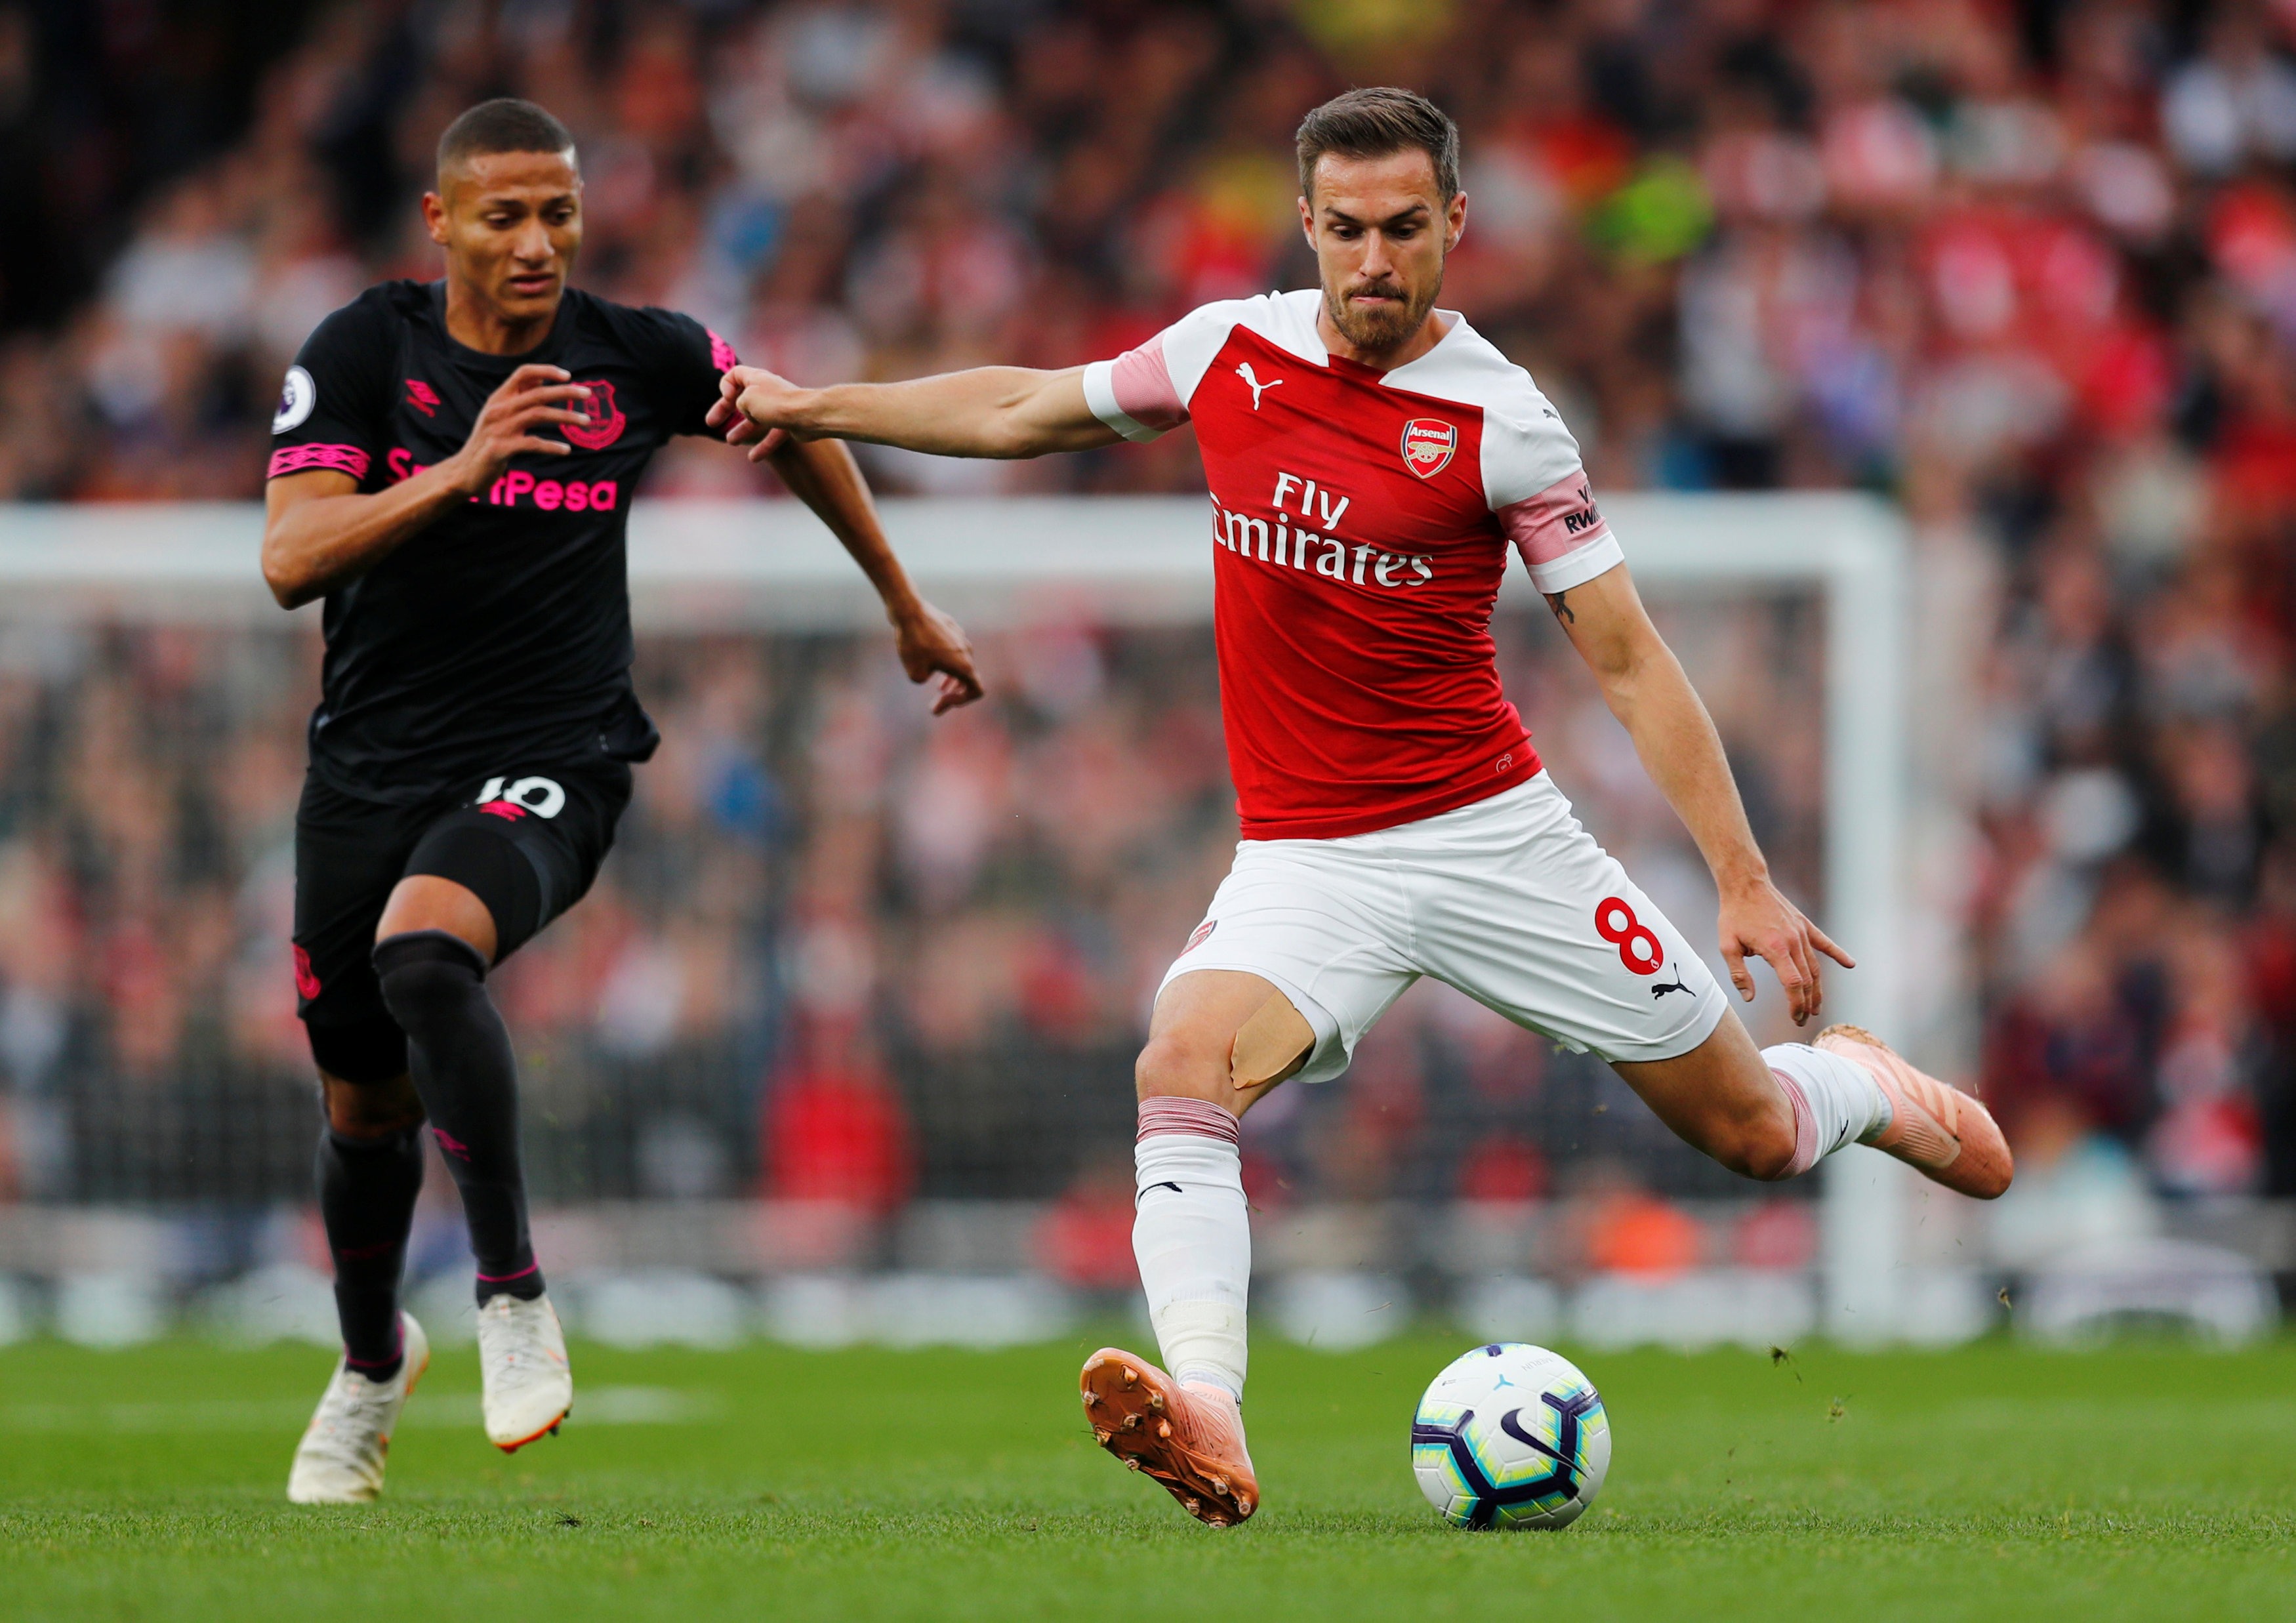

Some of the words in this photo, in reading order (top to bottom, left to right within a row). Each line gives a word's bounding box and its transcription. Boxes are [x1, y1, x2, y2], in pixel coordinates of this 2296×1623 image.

[1410, 426, 1450, 441] Arsenal
[386, 447, 618, 512] StPesa
[1272, 471, 1350, 531] Fly
[474, 775, 565, 819] 10
[1594, 896, 1664, 976] 8
